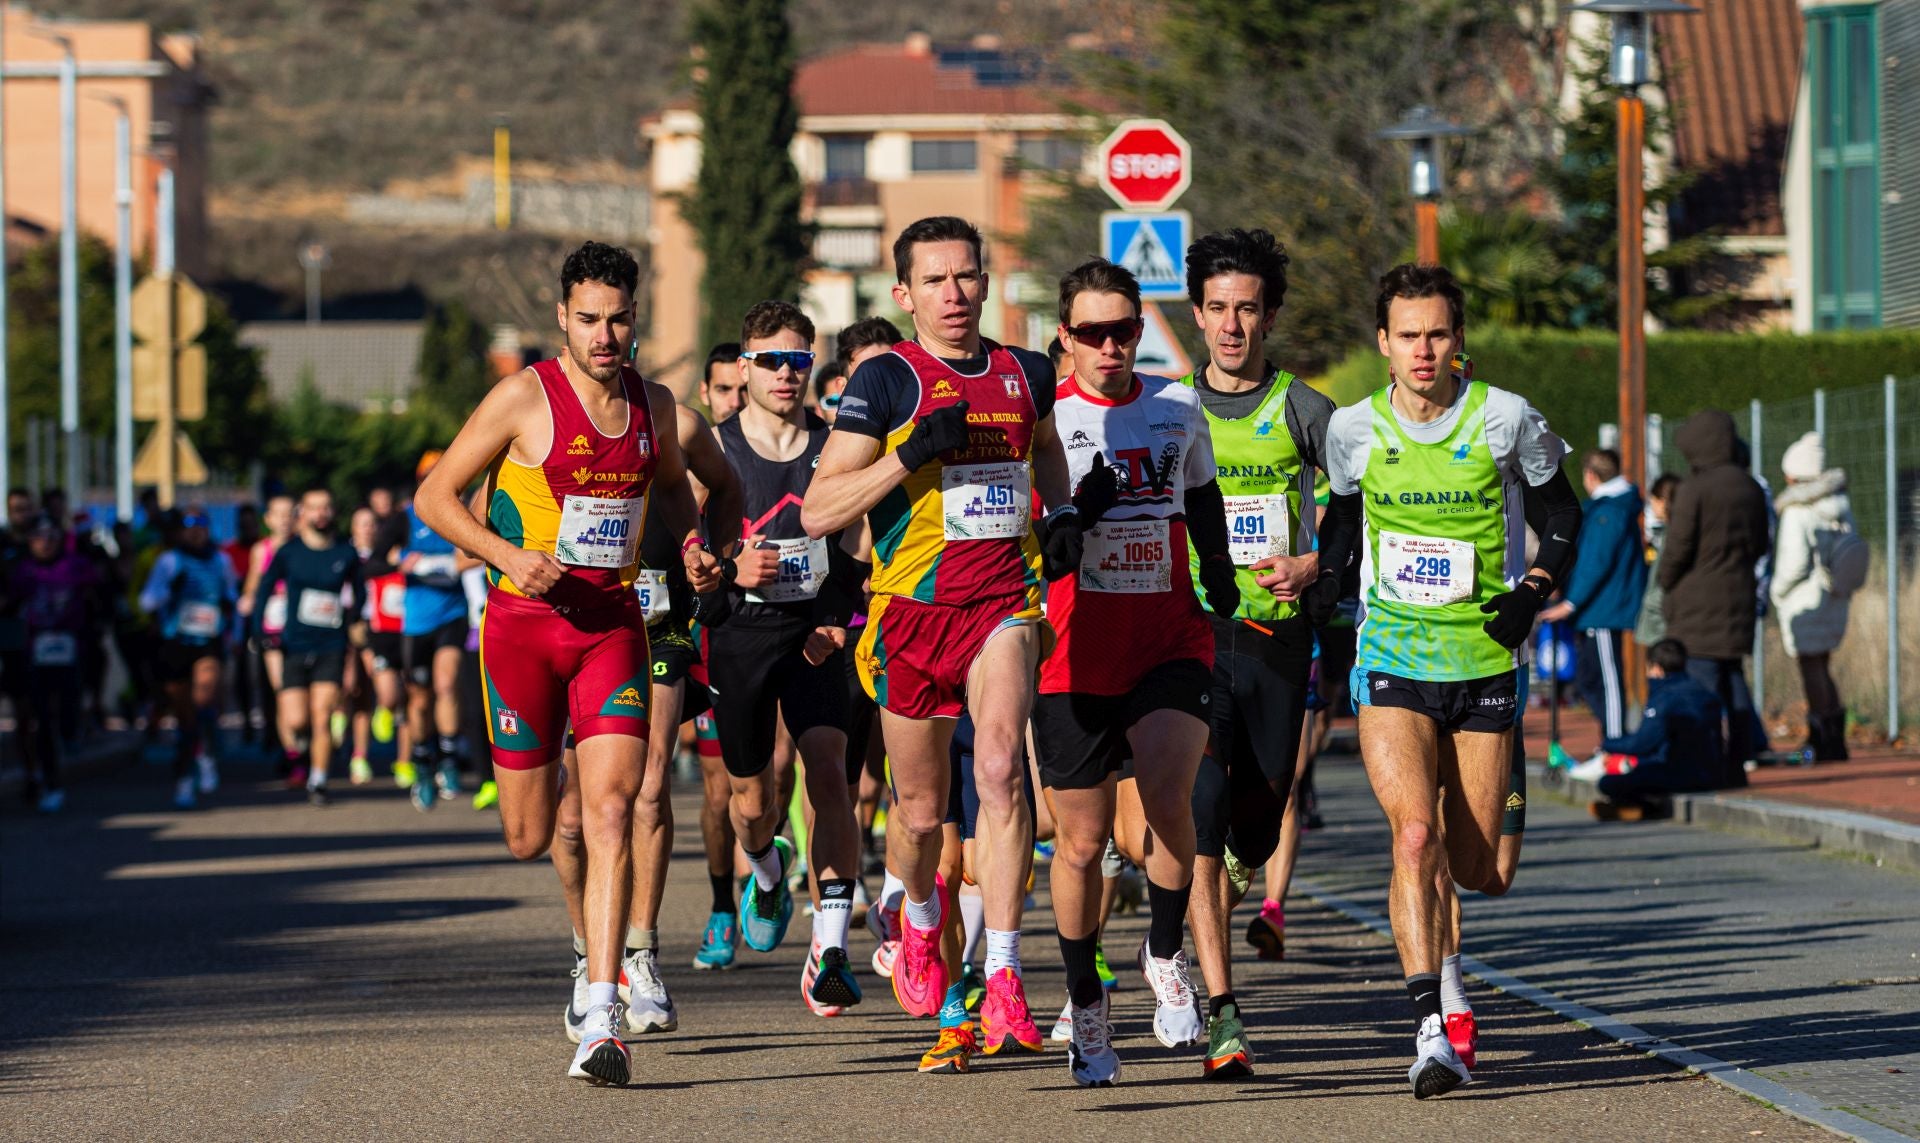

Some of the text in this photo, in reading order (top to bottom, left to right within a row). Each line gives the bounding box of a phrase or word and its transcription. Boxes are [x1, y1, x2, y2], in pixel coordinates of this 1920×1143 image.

[1110, 153, 1181, 180] STOP
[966, 412, 1024, 423] CAJA RURAL
[977, 446, 1019, 458] TORO
[594, 472, 645, 481] CAJA RURAL
[1217, 465, 1277, 478] RANJA
[986, 484, 1014, 506] 451
[1374, 490, 1474, 505] LA GRANJA
[1450, 506, 1475, 514] CHICO
[598, 518, 630, 538] 400
[1233, 515, 1265, 535] 491
[1123, 541, 1164, 563] 1065
[783, 555, 810, 575] 164
[1416, 556, 1450, 577] 298
